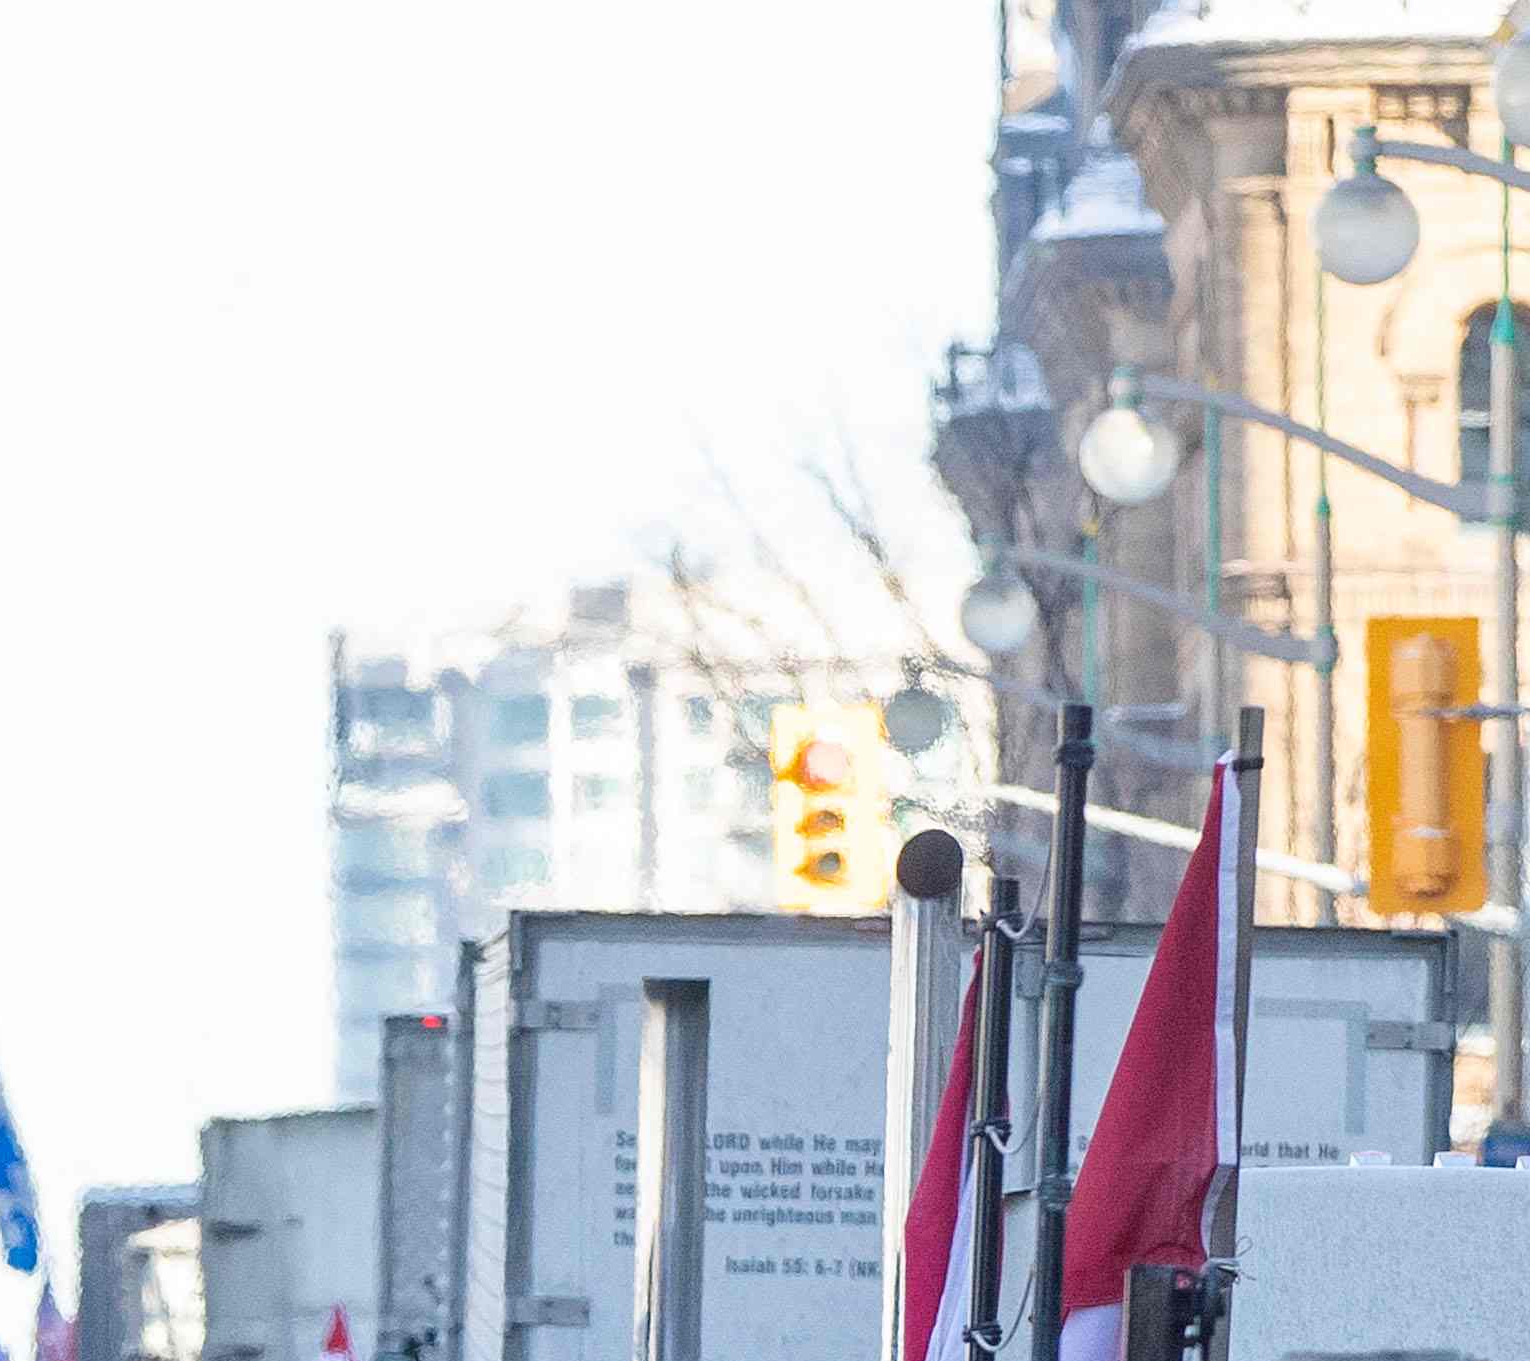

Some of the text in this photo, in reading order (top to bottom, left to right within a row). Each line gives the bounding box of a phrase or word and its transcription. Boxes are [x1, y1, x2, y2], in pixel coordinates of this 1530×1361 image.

[703, 1132, 750, 1151] ORD
[740, 1181, 801, 1199] wicked
[811, 1183, 876, 1201] forsake
